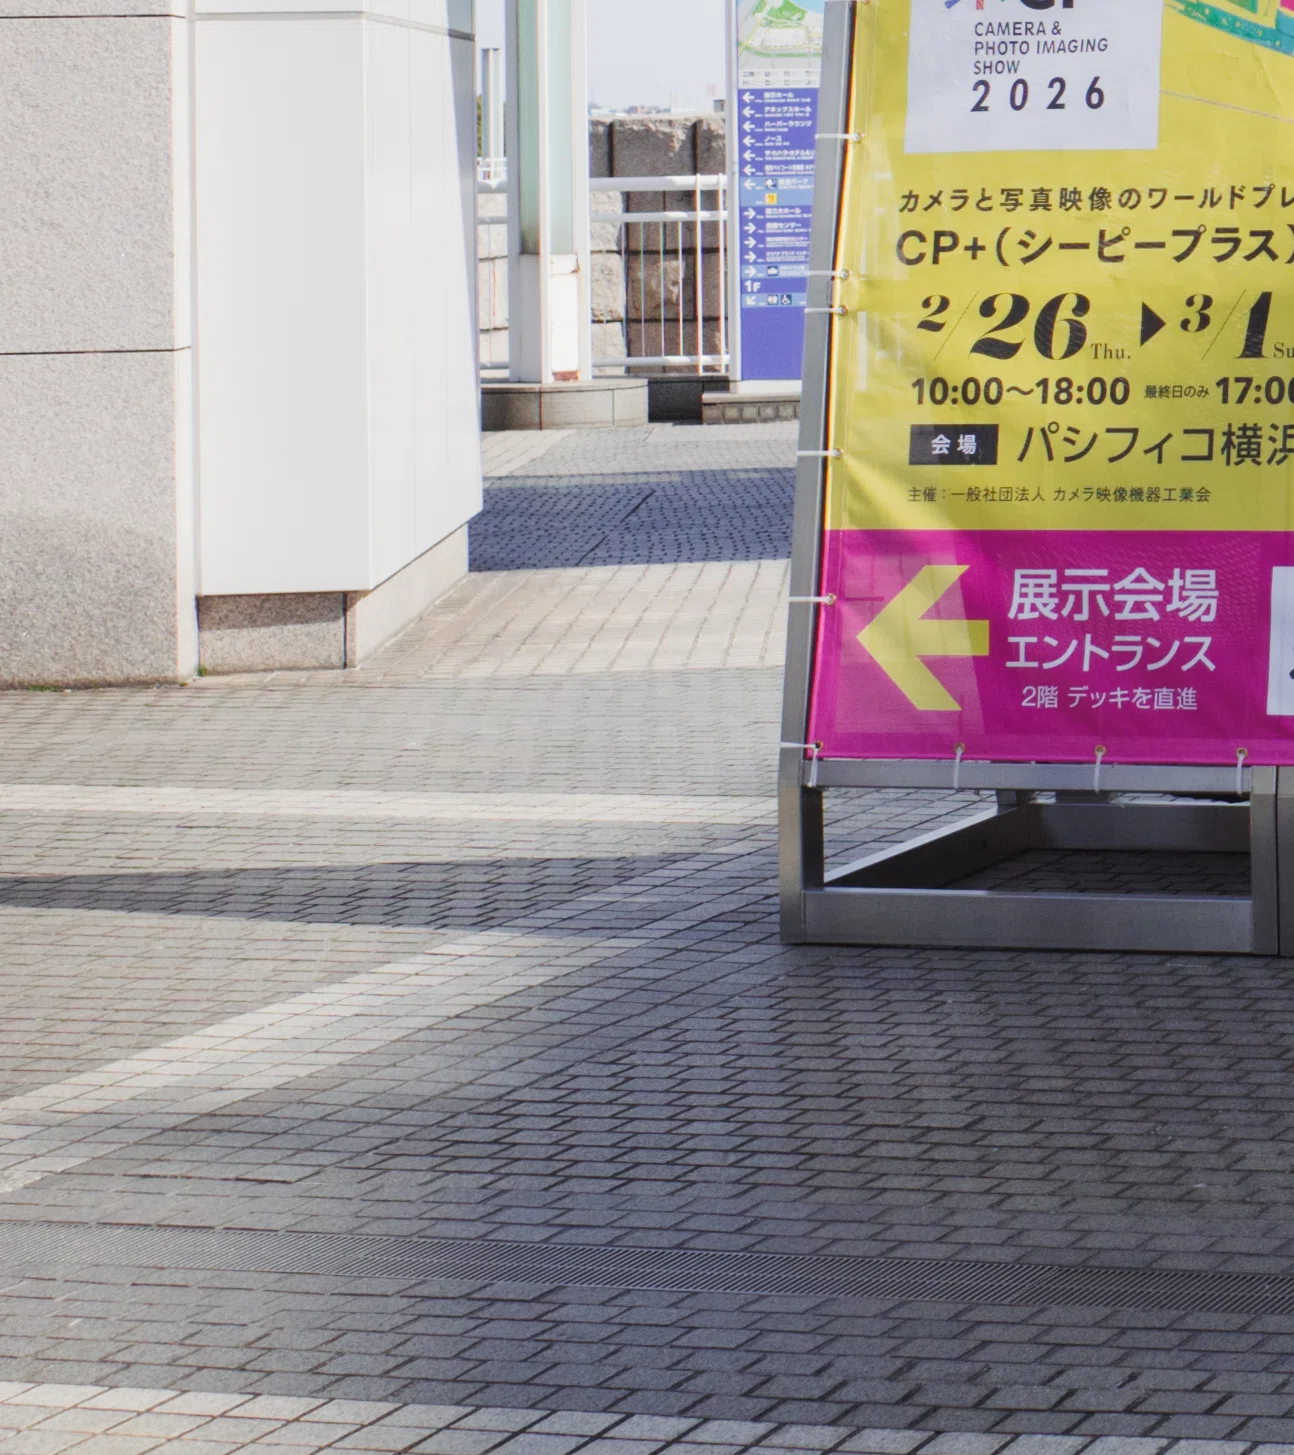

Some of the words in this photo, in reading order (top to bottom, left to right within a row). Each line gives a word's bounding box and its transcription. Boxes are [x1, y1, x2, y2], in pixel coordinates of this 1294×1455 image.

[974, 21, 1045, 37] CAMERA
[1051, 21, 1062, 36] &
[974, 39, 1029, 56] PHOTO
[1036, 37, 1109, 55] IMAGING
[974, 60, 1020, 75] SHOW
[970, 76, 1105, 112] 2026
[744, 279, 762, 293] 1F
[1090, 341, 1132, 360] Thu.
[1144, 384, 1210, 400] 最終日のみ
[931, 434, 978, 455] 会場
[1053, 486, 1212, 503] カメラ映像機器工業会
[1008, 567, 1219, 623] 展示会場
[1005, 634, 1216, 672] エントランス
[1022, 686, 1058, 709] 2階
[1067, 686, 1198, 710] デッキを直進
